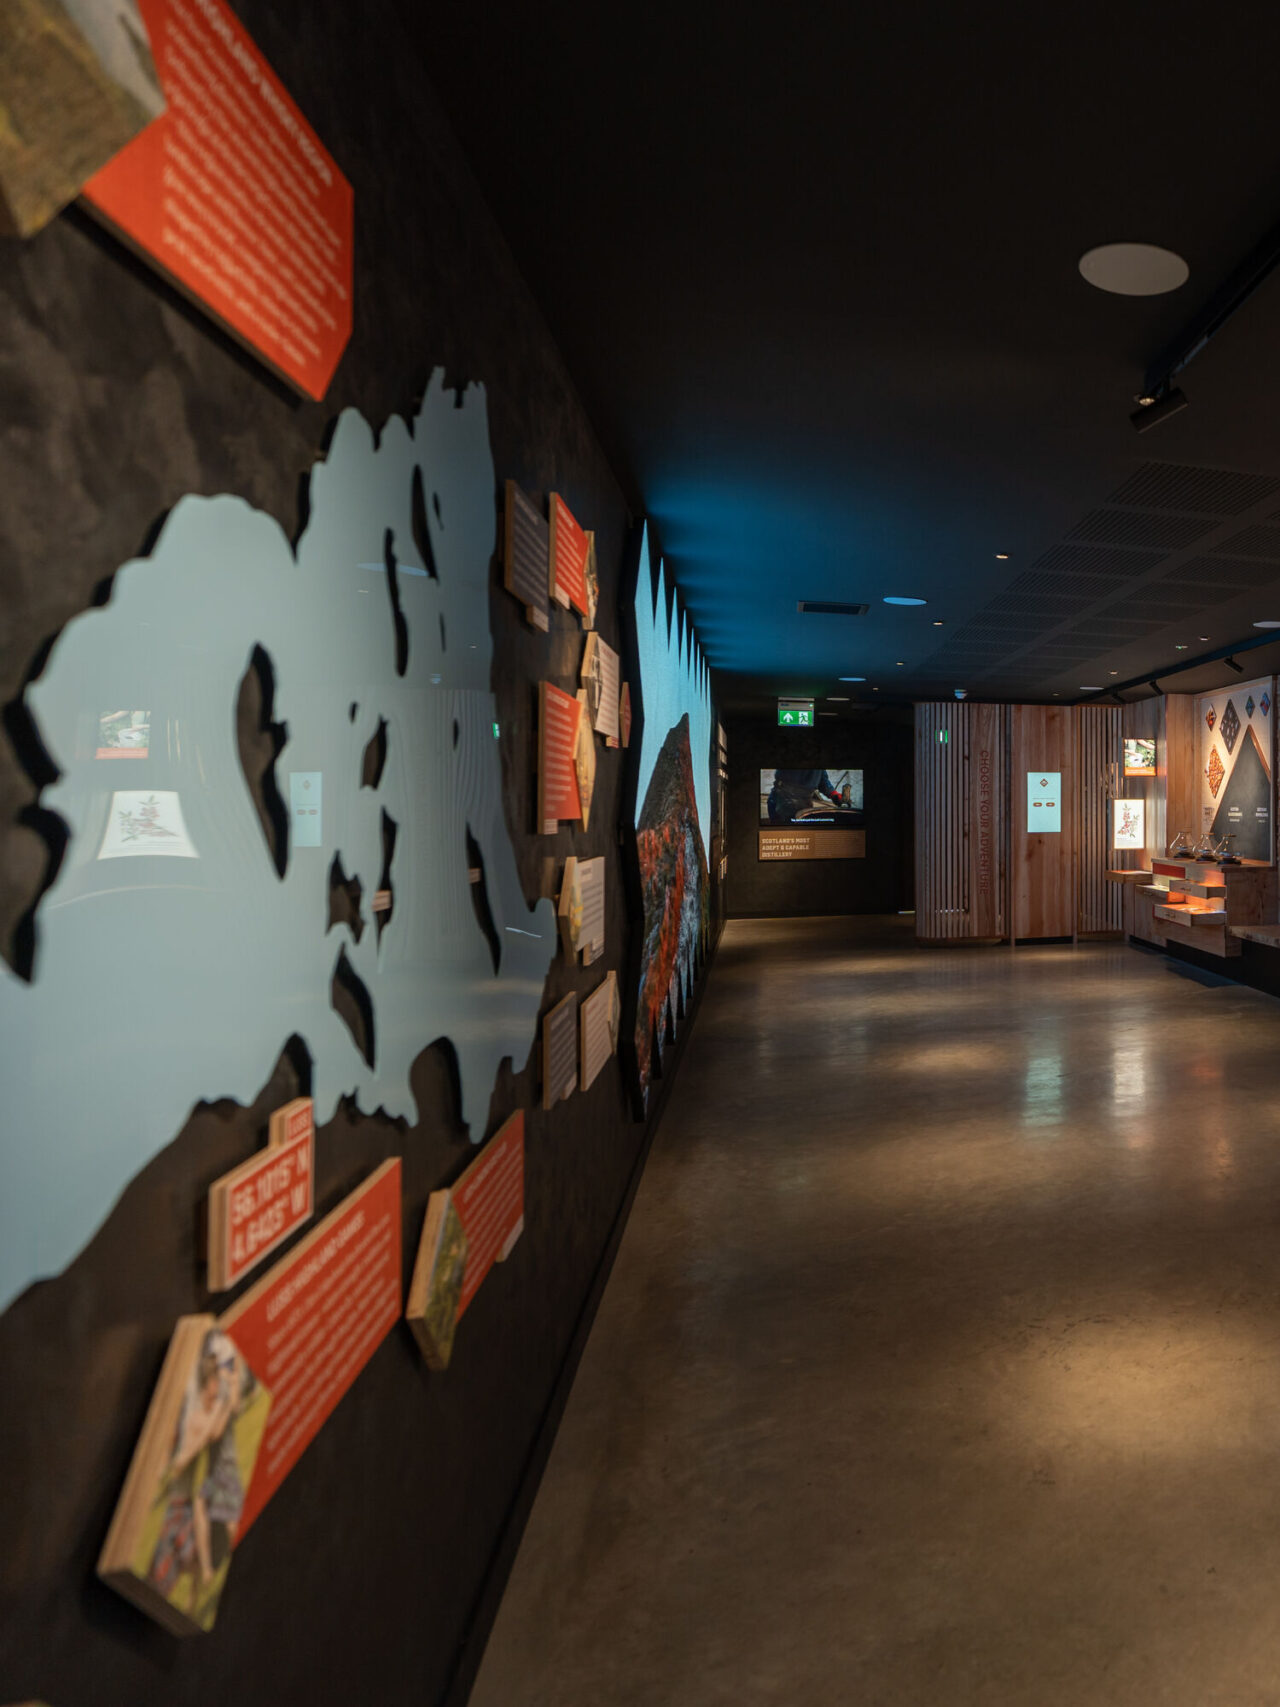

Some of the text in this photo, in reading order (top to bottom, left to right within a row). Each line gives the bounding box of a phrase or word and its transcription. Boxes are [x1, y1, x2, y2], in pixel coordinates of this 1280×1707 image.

[980, 750, 990, 895] CHOOSE YOUR ADVENTURE
[296, 1145, 309, 1176] N
[290, 1183, 307, 1216] W
